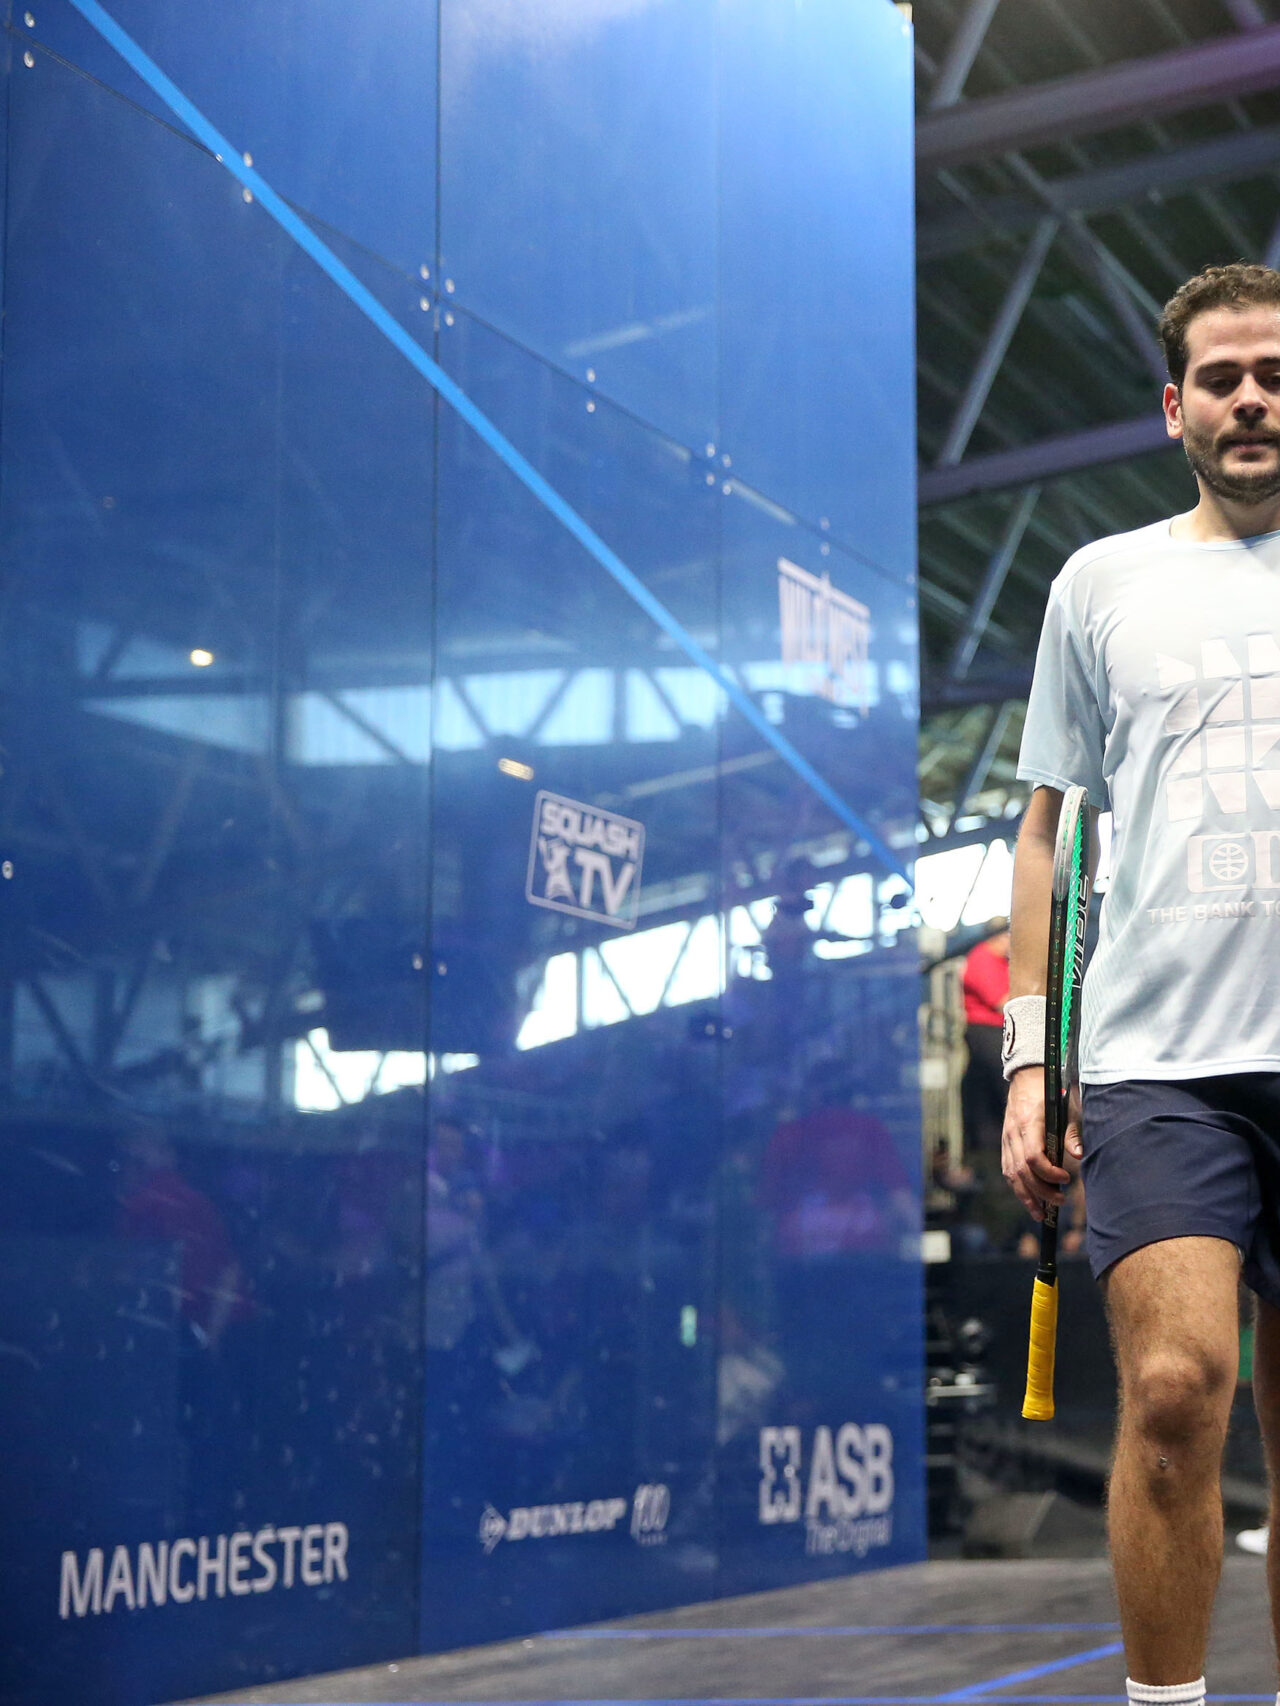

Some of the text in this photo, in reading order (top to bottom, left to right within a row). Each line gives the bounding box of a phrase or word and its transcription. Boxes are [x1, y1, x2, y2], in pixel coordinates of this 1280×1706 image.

[541, 801, 640, 863] SQUASH
[574, 846, 636, 917] TV
[1147, 905, 1187, 924] THE
[1193, 901, 1255, 920] BANK
[805, 1421, 895, 1521] ASB
[505, 1497, 627, 1541] DUNLOP
[58, 1521, 349, 1620] MANCHESTER
